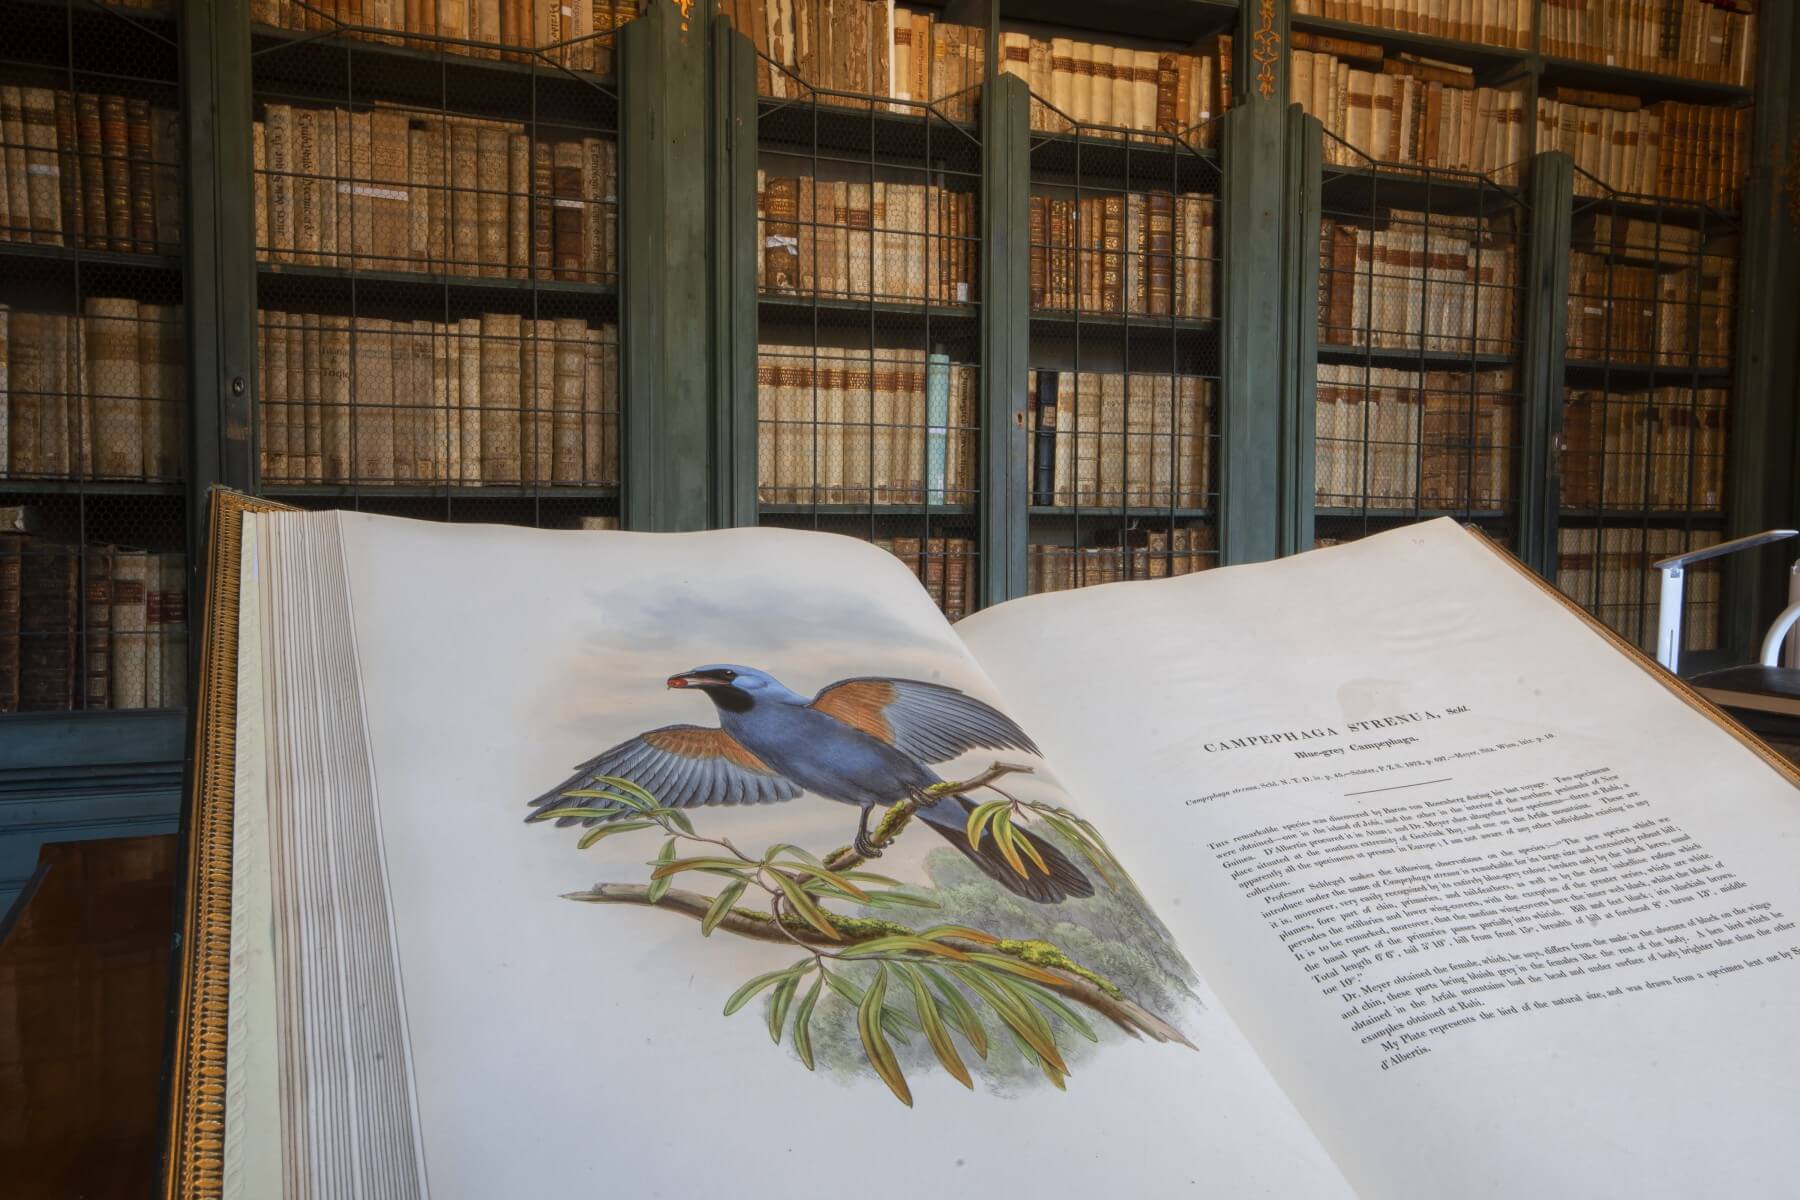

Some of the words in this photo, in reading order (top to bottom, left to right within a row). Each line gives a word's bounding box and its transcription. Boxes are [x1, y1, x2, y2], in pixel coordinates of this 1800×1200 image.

[1203, 727, 1339, 753] CAMPEPHAGA
[1348, 709, 1441, 733] STRENUA,
[1293, 746, 1345, 760] Blue-grey
[1349, 735, 1420, 751] Campephaga.
[1246, 880, 1290, 898] collection.
[1323, 985, 1338, 997] toe
[1341, 1005, 1360, 1020] and
[1361, 999, 1386, 1011] chin,
[1386, 990, 1412, 1001] these
[1414, 983, 1438, 996] parts
[1439, 976, 1468, 986] being
[1466, 970, 1495, 980] bluish
[1352, 1009, 1392, 1031] obtained
[1393, 1005, 1407, 1014] in
[1410, 1000, 1427, 1009] the
[1431, 990, 1457, 1003] Arfak
[1461, 982, 1506, 995] mountains
[1361, 1023, 1405, 1044] examples
[1406, 1007, 1446, 1026] obtained
[1447, 1005, 1458, 1013] at
[1457, 998, 1485, 1010] Rubi.
[1380, 1040, 1400, 1052] My
[1400, 1031, 1427, 1044] Plate
[1429, 1017, 1476, 1034] represents
[1479, 1011, 1495, 1020] the
[1496, 1005, 1519, 1016] bird
[1380, 1045, 1431, 1071] d'Albertis.
